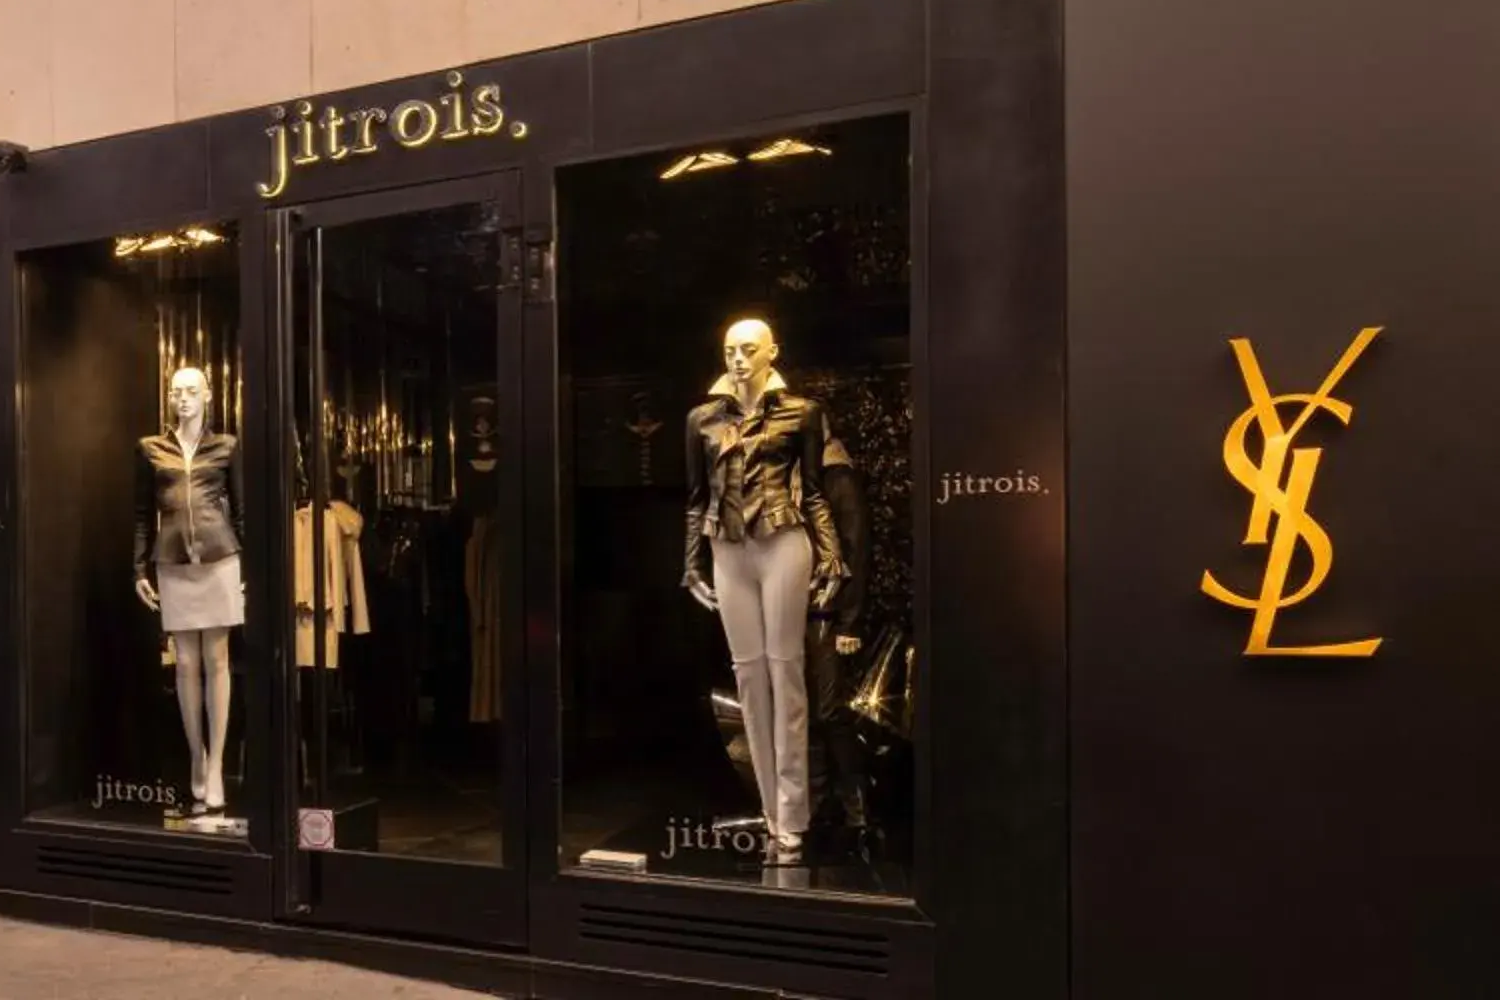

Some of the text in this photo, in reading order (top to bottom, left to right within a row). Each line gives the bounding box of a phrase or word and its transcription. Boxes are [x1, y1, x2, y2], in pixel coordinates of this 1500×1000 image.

[256, 70, 528, 197] jitrois.
[936, 469, 1050, 505] jitrois.
[1200, 325, 1386, 657] YSL
[91, 774, 184, 809] jitrois.
